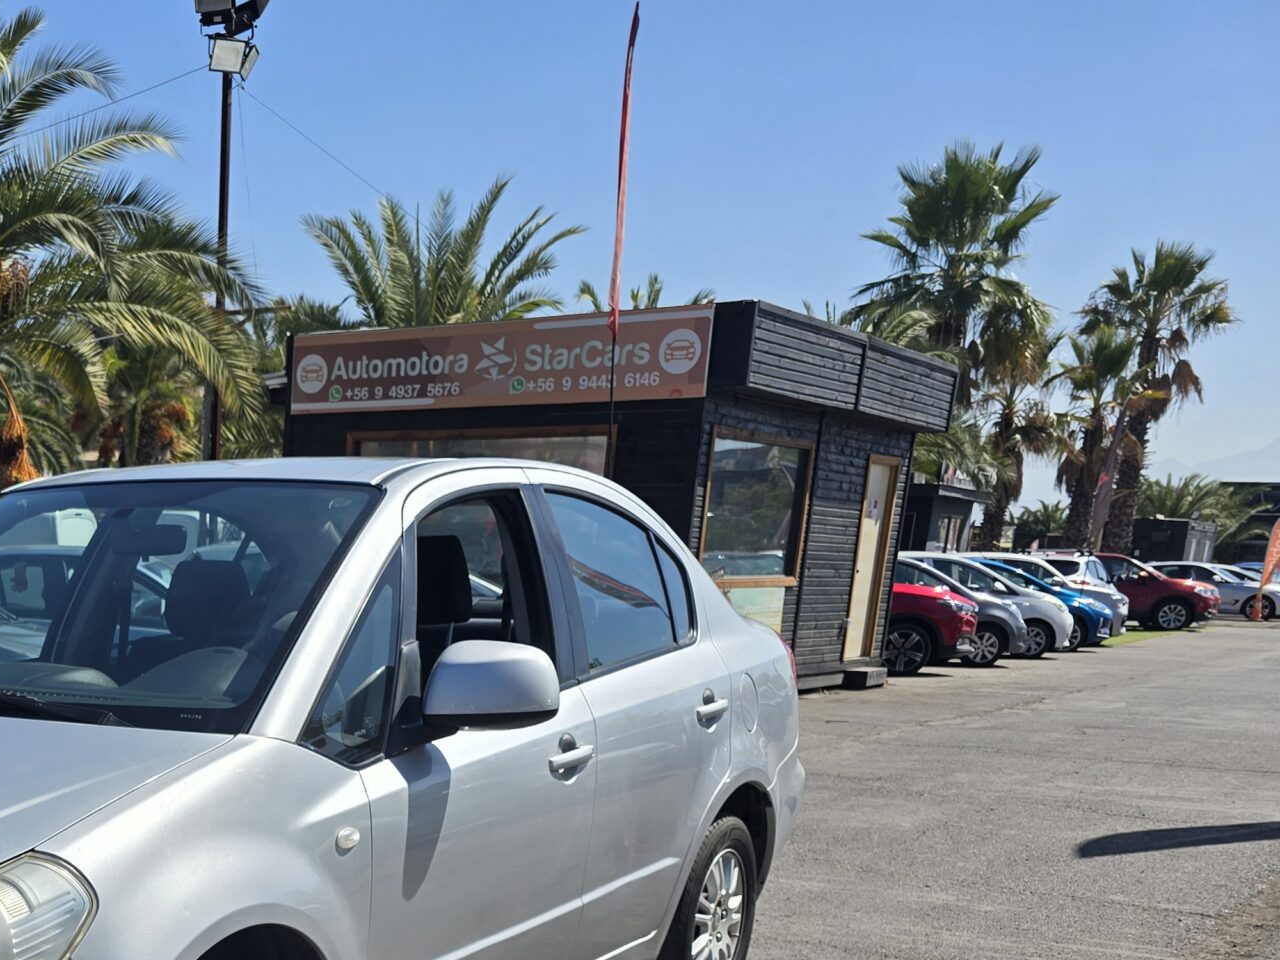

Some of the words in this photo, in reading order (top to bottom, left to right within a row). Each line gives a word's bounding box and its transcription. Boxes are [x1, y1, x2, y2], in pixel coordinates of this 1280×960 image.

[331, 351, 468, 381] Automotora
[523, 341, 650, 372] StarCars
[345, 386, 369, 400] +56
[374, 386, 383, 399] 9
[388, 384, 421, 399] 4937
[427, 382, 460, 397] 5676
[527, 378, 555, 392] +56
[562, 377, 572, 390] 9
[624, 371, 660, 387] 6146
